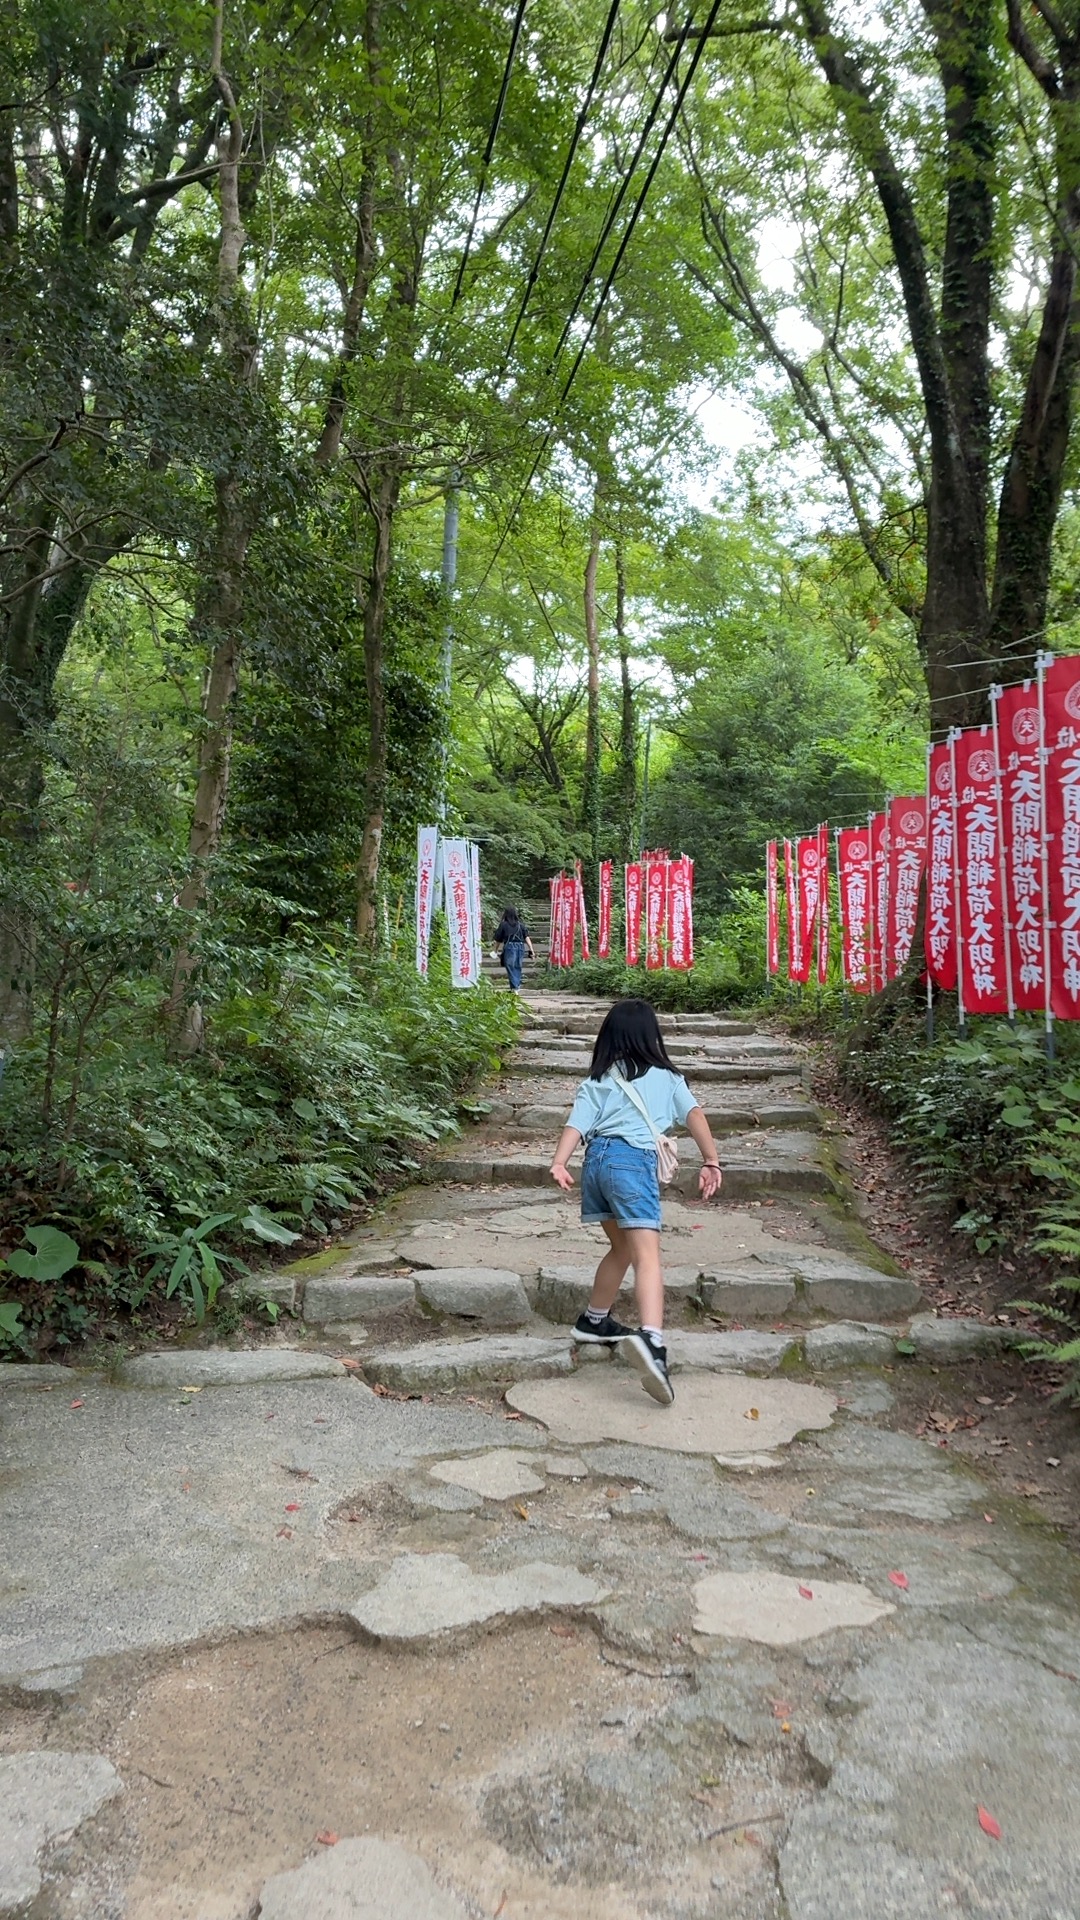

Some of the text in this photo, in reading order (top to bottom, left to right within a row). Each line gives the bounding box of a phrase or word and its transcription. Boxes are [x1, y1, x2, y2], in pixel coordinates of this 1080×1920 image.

[452, 879, 470, 979] 天開稲荷大明神
